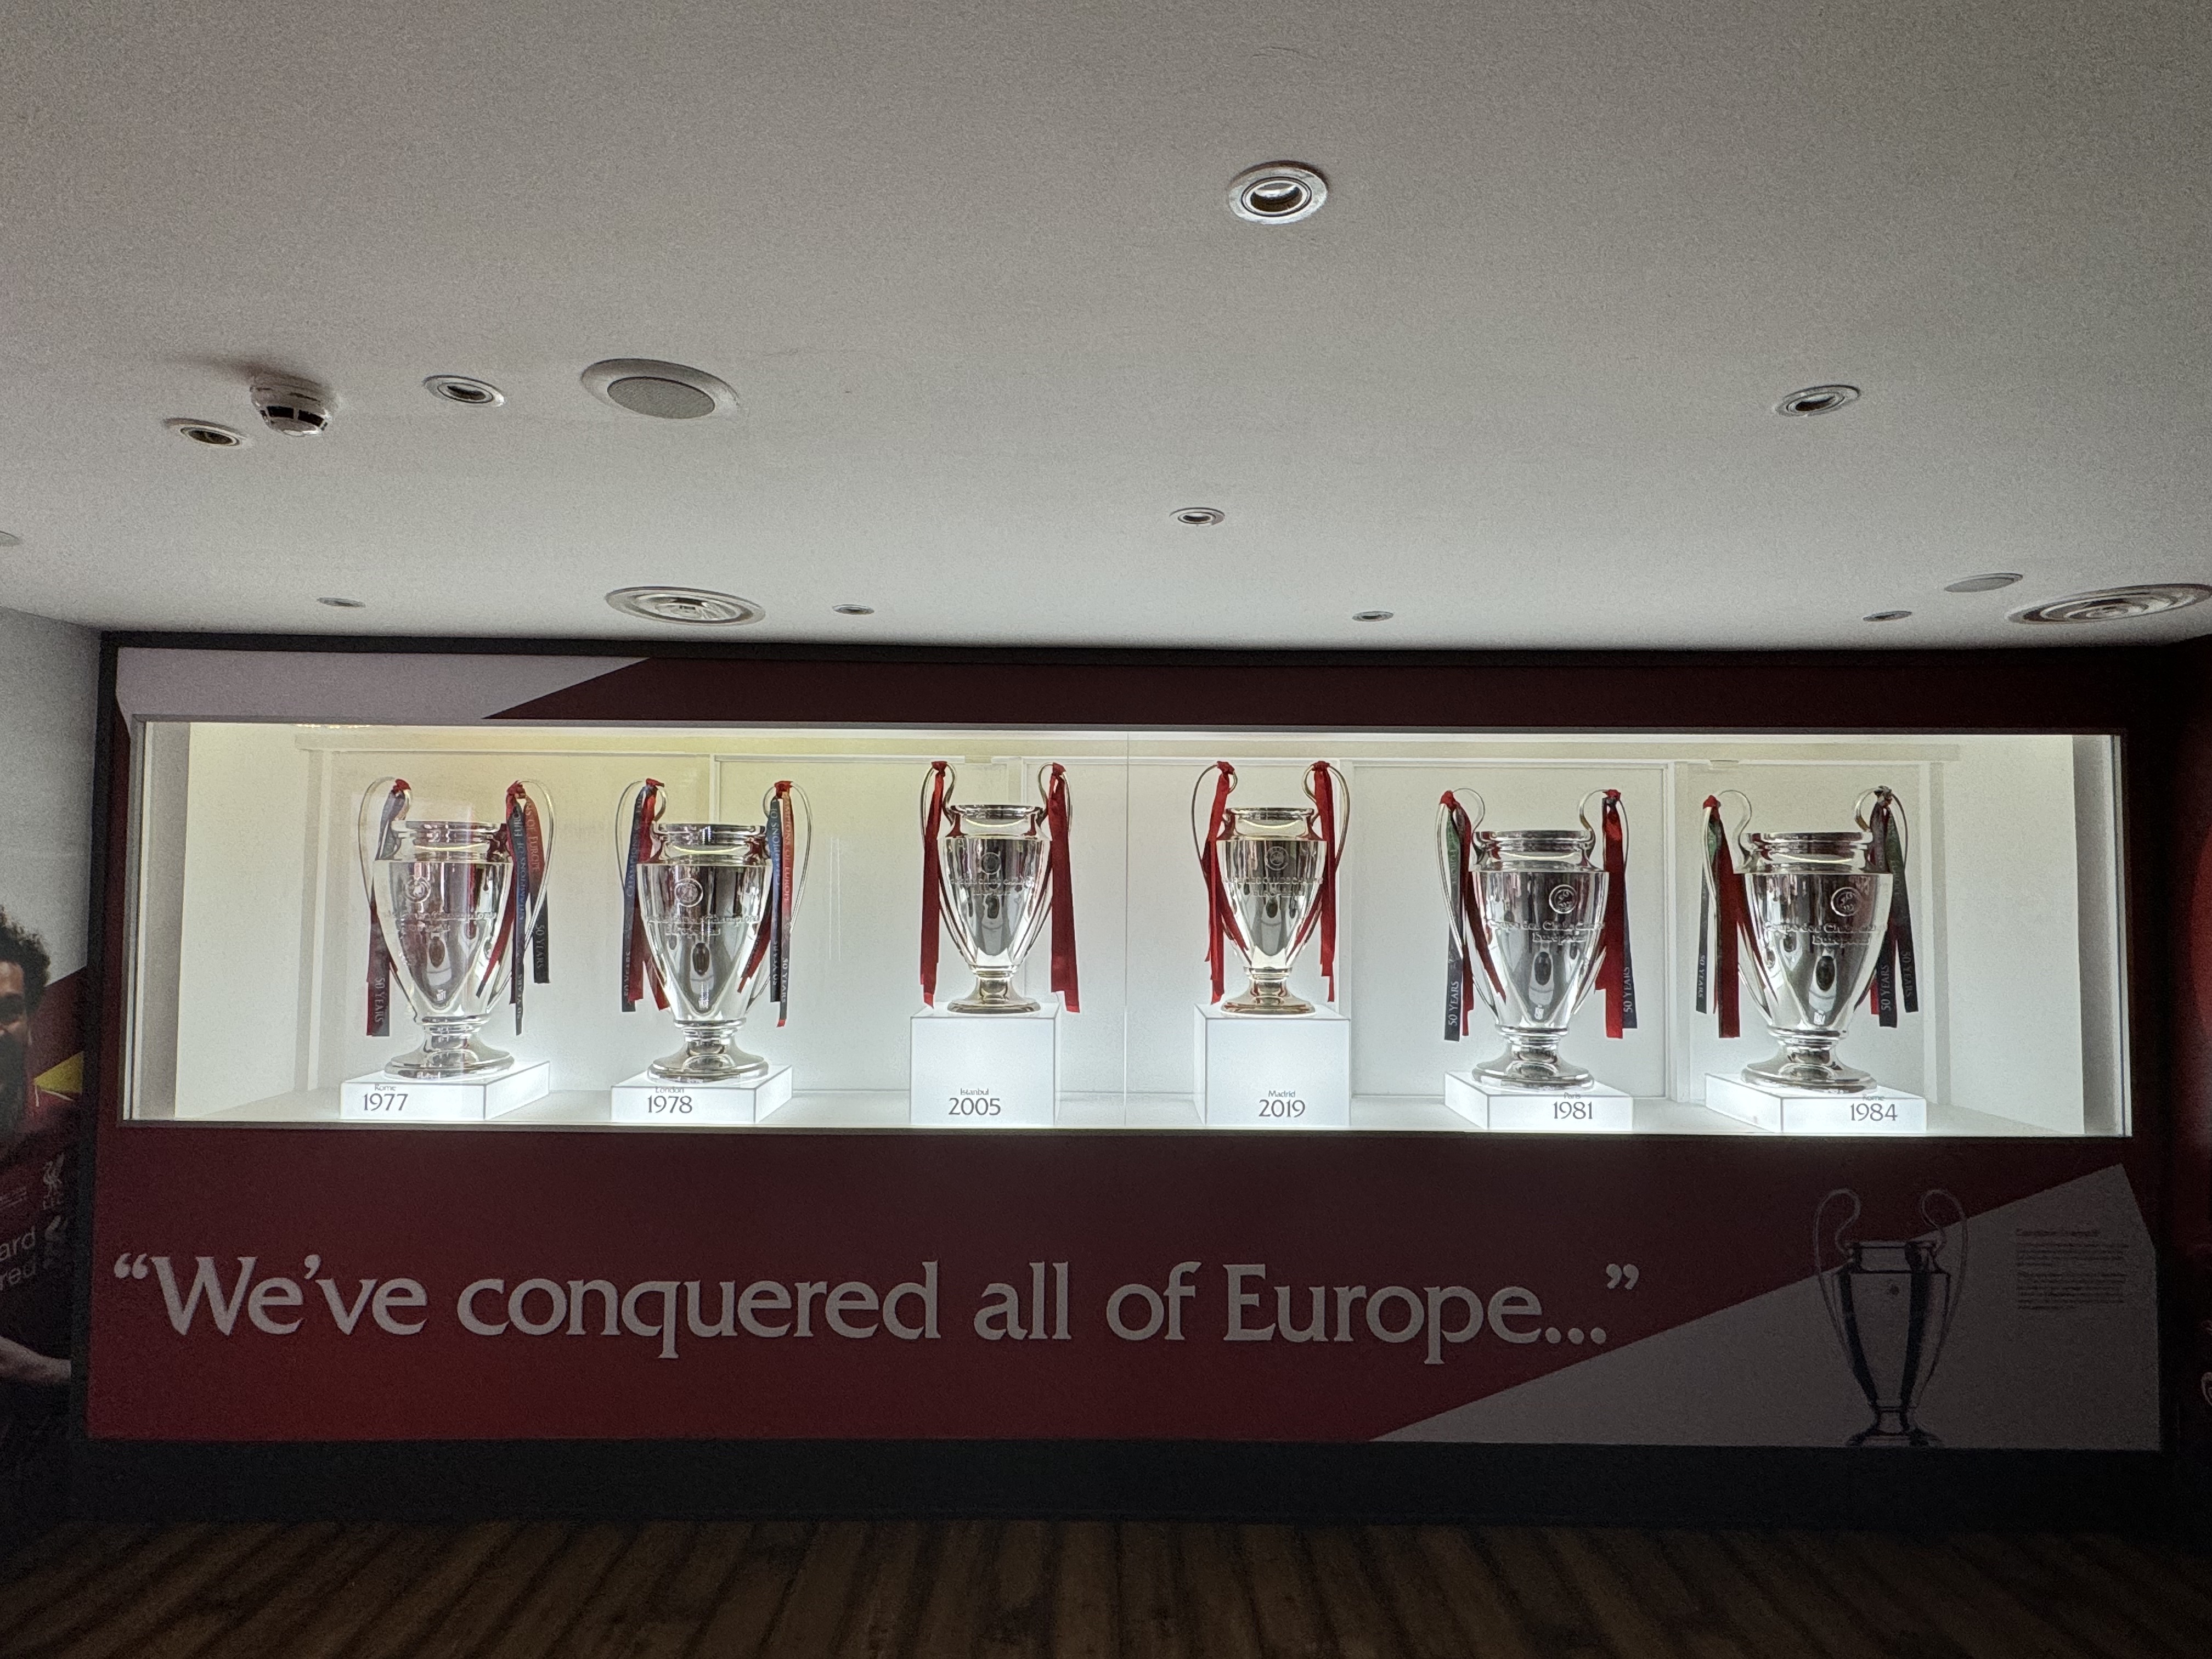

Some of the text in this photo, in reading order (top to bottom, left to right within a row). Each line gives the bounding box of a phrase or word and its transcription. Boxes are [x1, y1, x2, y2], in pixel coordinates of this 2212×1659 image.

[783, 867, 792, 904] EUROPE
[536, 924, 545, 969] 50 YEARS
[1900, 950, 1914, 997] 50 YEARS
[1881, 964, 1892, 1012] 50 YEARS
[374, 978, 386, 1023] 50 YEARS
[1448, 981, 1459, 1026] 50 YEARS
[1623, 1001, 1633, 1013] 50
[960, 1087, 989, 1096] Istanbul
[1268, 1090, 1296, 1098] Madrid
[364, 1093, 409, 1111] 1977
[647, 1095, 692, 1114] 1978
[948, 1097, 1001, 1116] 2005
[1259, 1099, 1306, 1118] 2019
[1553, 1101, 1593, 1119] 1981
[1850, 1103, 1898, 1121] 1984
[456, 1260, 942, 1359] conquered
[973, 1261, 1072, 1341] all
[1105, 1261, 1203, 1341] of
